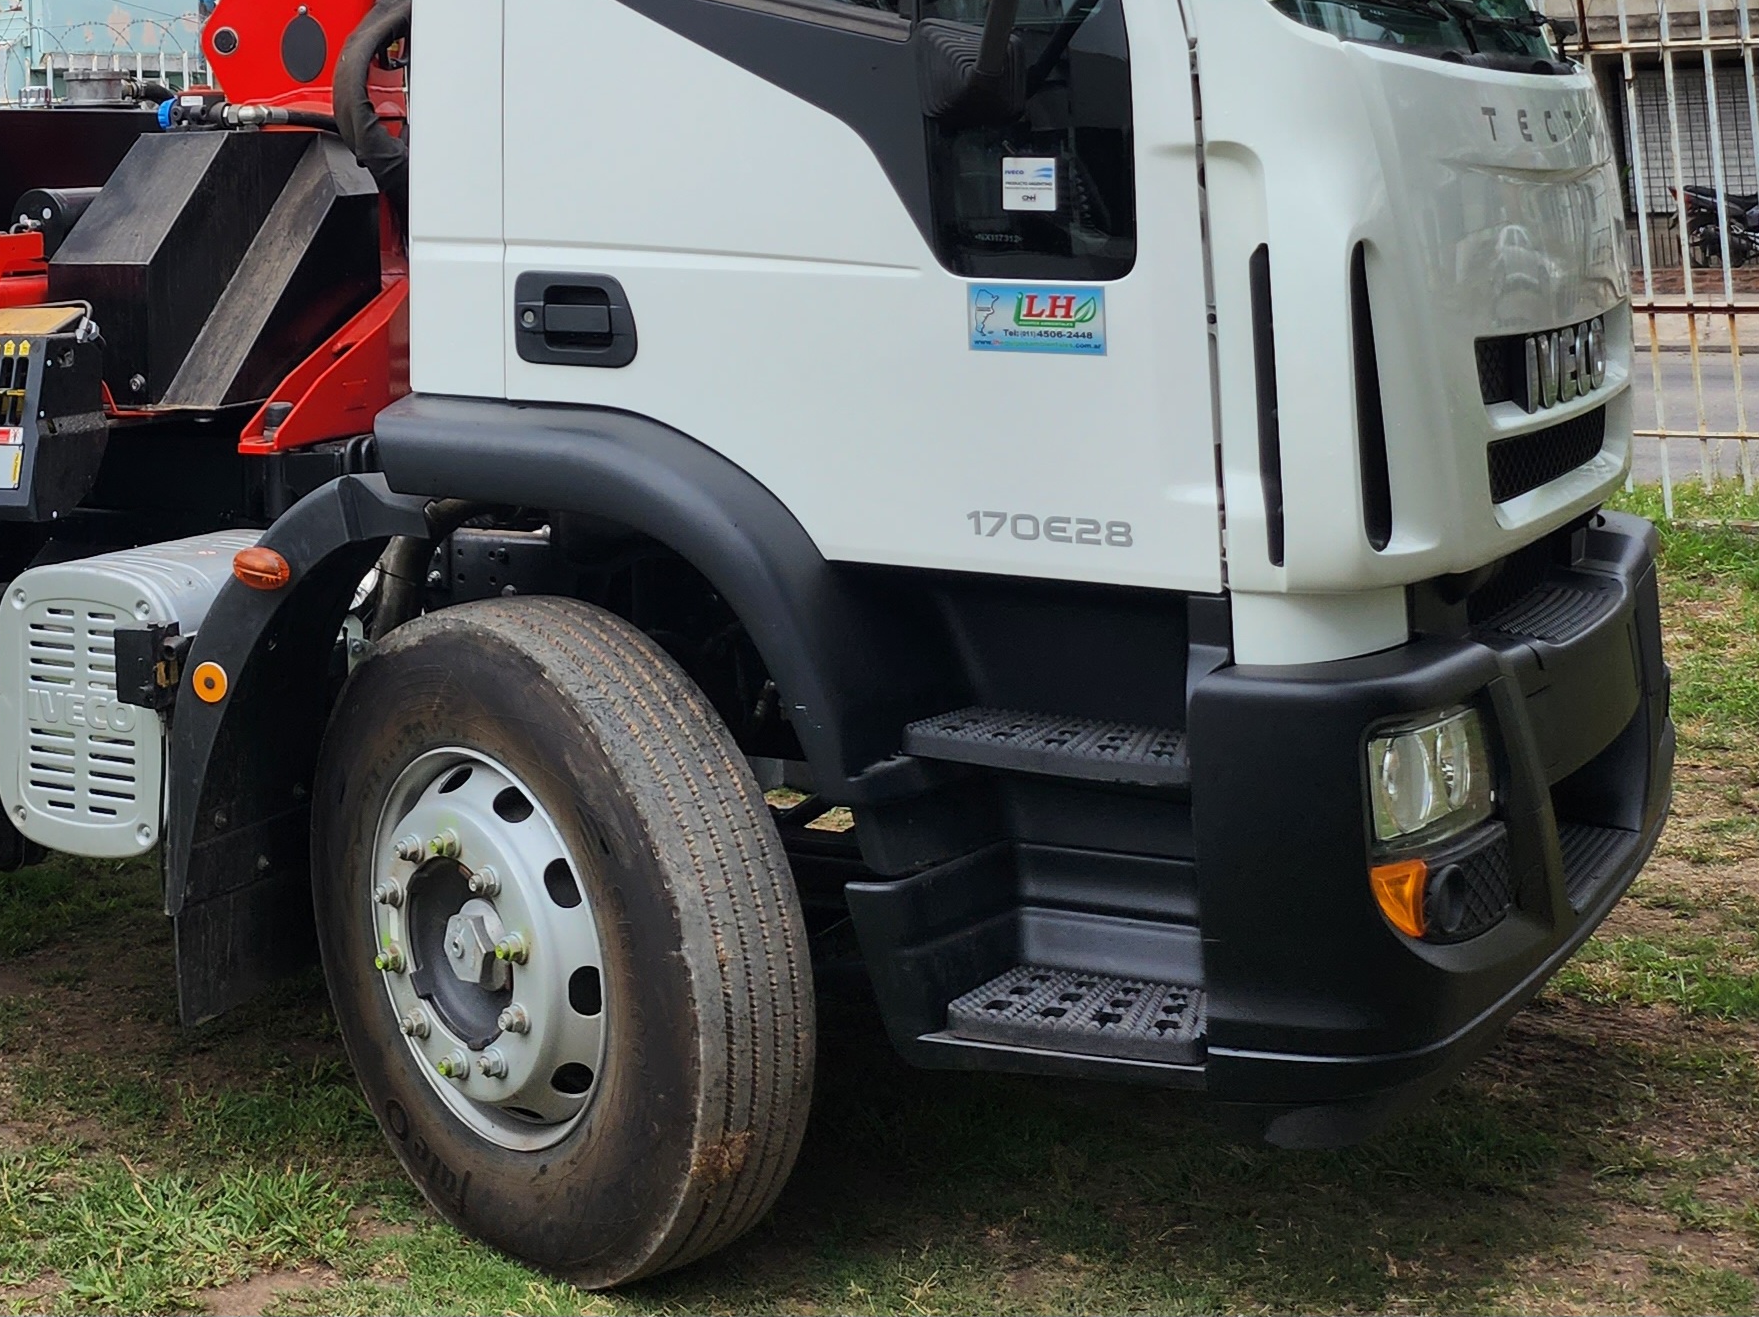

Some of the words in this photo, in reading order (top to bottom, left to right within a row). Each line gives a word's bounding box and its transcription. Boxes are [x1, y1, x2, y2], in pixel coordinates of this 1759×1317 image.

[1023, 294, 1076, 319] LH
[1037, 330, 1093, 339] 4506-2448
[1526, 319, 1606, 414] IVECO
[966, 510, 1133, 548] 170E28
[28, 688, 136, 733] IVECO
